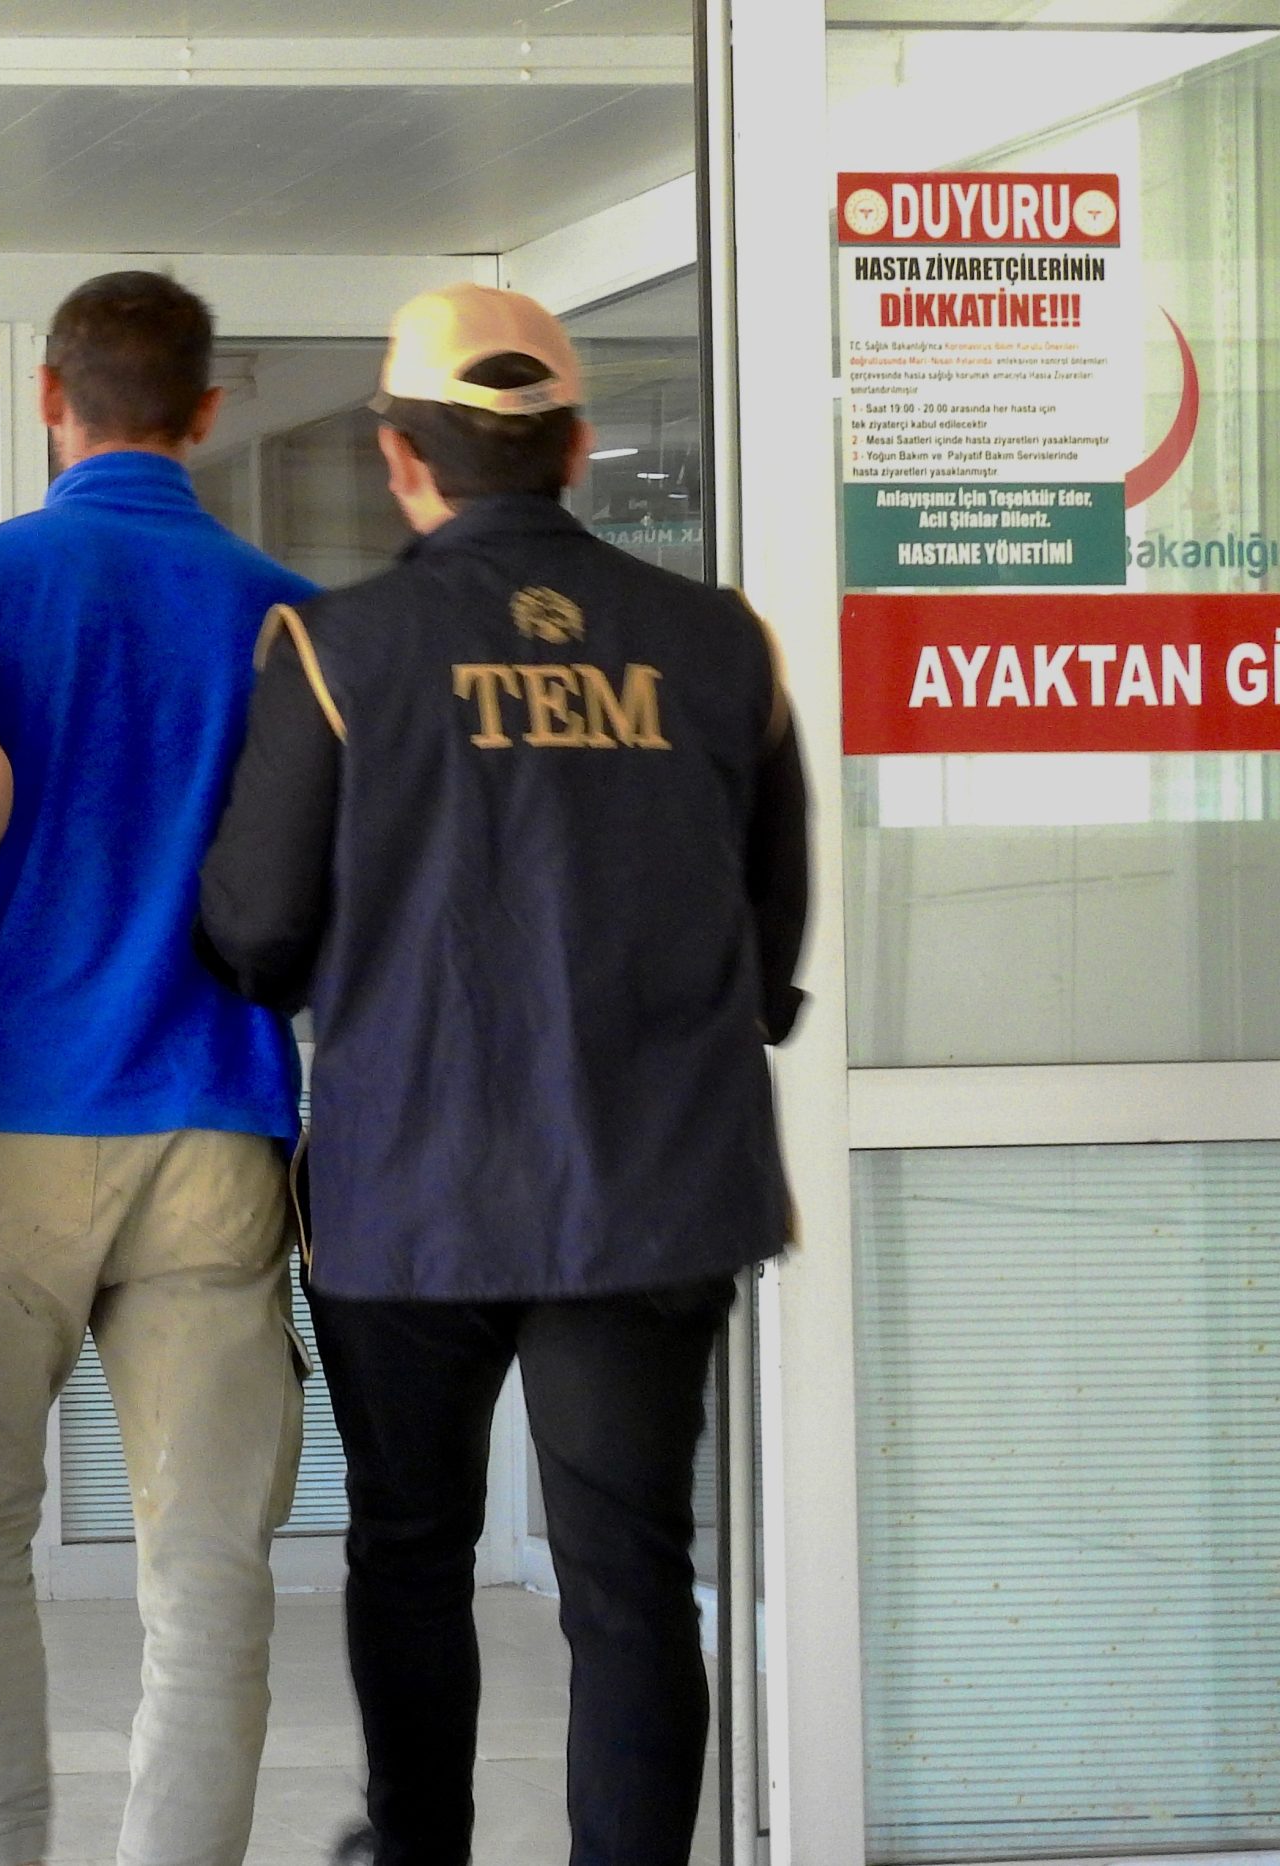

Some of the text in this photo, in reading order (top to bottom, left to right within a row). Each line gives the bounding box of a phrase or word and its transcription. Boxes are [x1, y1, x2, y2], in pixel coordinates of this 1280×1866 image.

[891, 183, 1070, 240] DUYURU
[855, 253, 1105, 286] HASTA ZİYARETÇİLERİNİN
[880, 287, 1080, 328] DİKKATİNE!!!
[866, 403, 887, 414] Saat
[993, 404, 1008, 413] her
[1011, 404, 1037, 413] hasta
[851, 420, 866, 429] tek
[910, 420, 937, 429] kabul
[866, 435, 894, 445] Mesai
[896, 434, 932, 445] Saatleri
[934, 435, 963, 447] içinde
[965, 435, 991, 445] hasta
[993, 435, 1039, 447] ziyaretleri
[866, 450, 897, 463] Yoğun
[898, 450, 929, 461] Bakım
[947, 450, 983, 463] Palyatif
[984, 450, 1015, 461] Bakım
[852, 467, 879, 477] hasta
[881, 467, 927, 479] ziyaretleri
[989, 489, 1056, 509] Teşekkür
[898, 538, 1073, 565] HASTANE YÖNETİMİ
[908, 628, 1280, 709] AYAKTAN G
[450, 662, 673, 751] TEM
